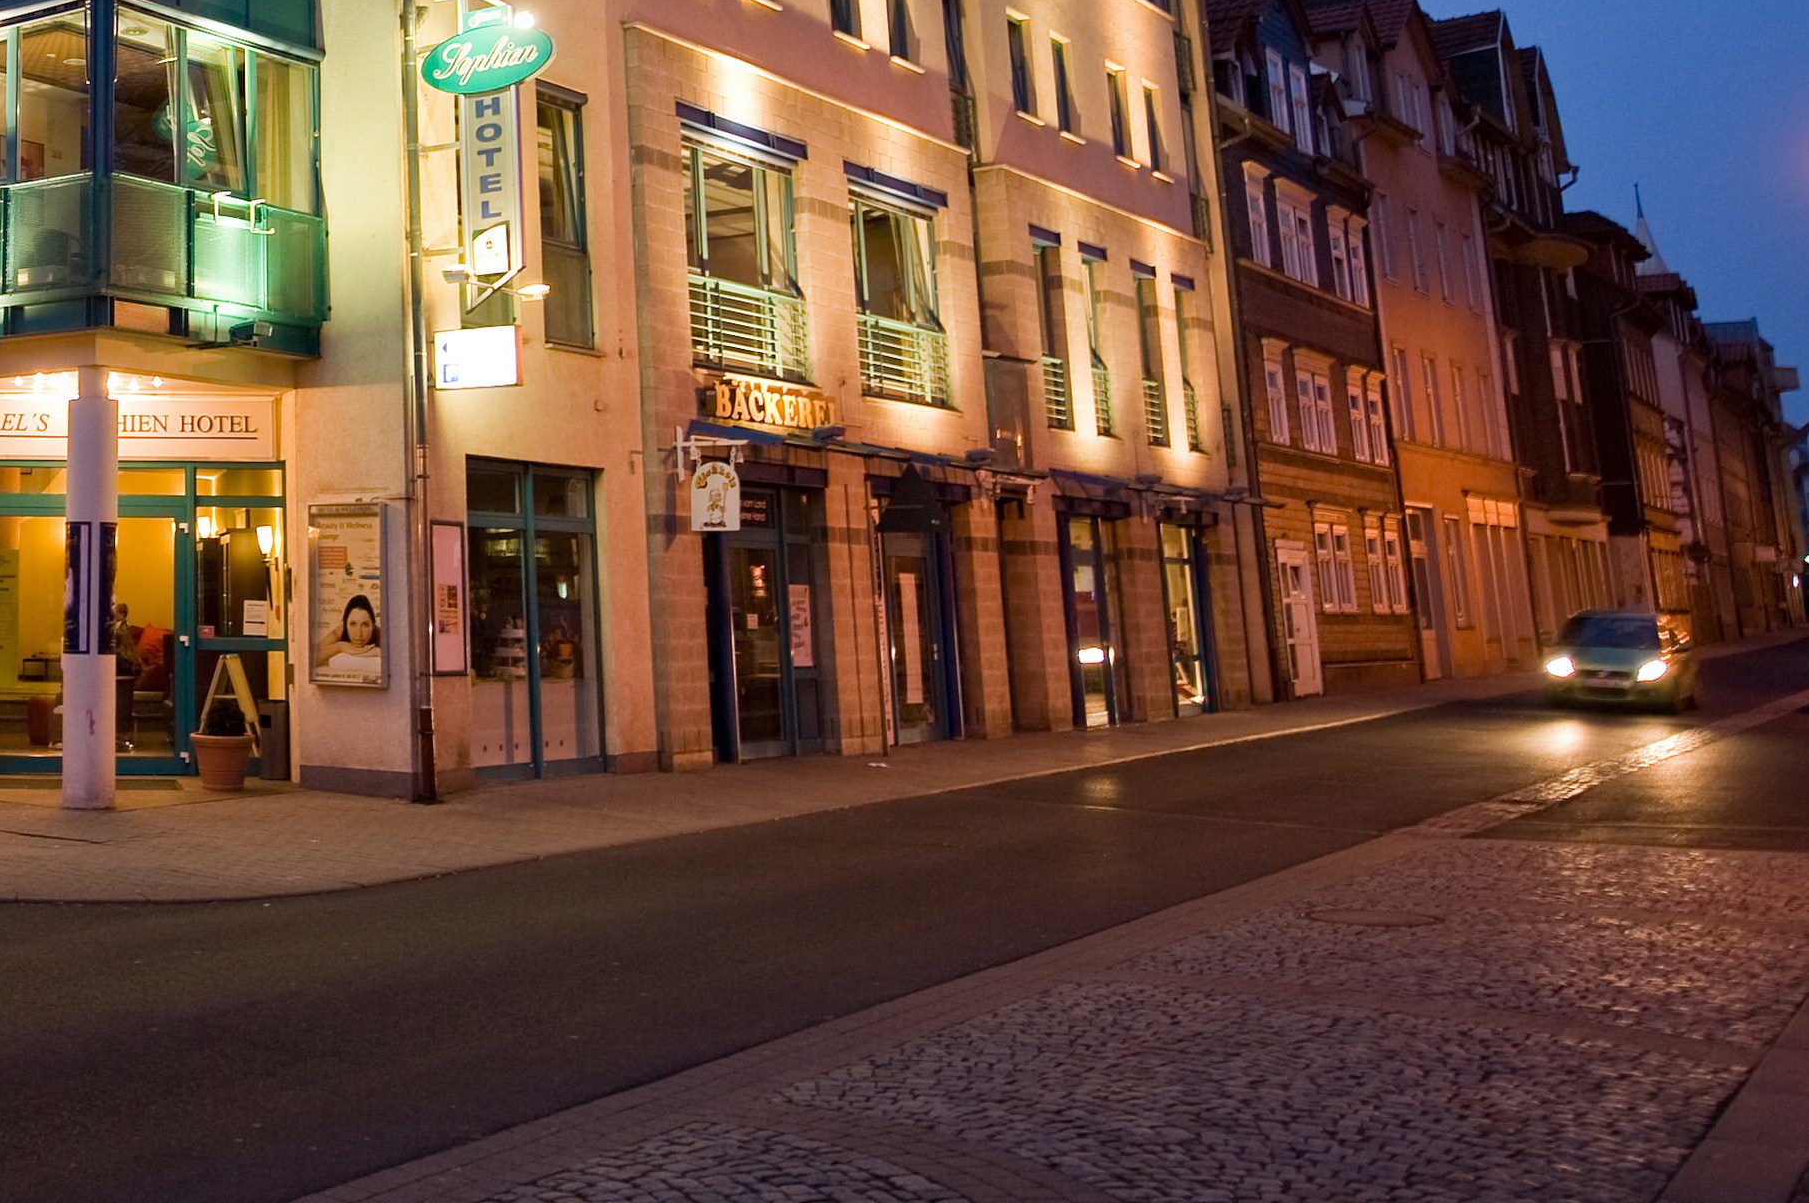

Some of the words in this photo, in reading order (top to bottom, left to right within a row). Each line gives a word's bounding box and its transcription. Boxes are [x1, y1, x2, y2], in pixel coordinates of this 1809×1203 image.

[433, 35, 539, 86] Sophien
[474, 96, 503, 220] HOTEL
[180, 414, 258, 433] HOTEL
